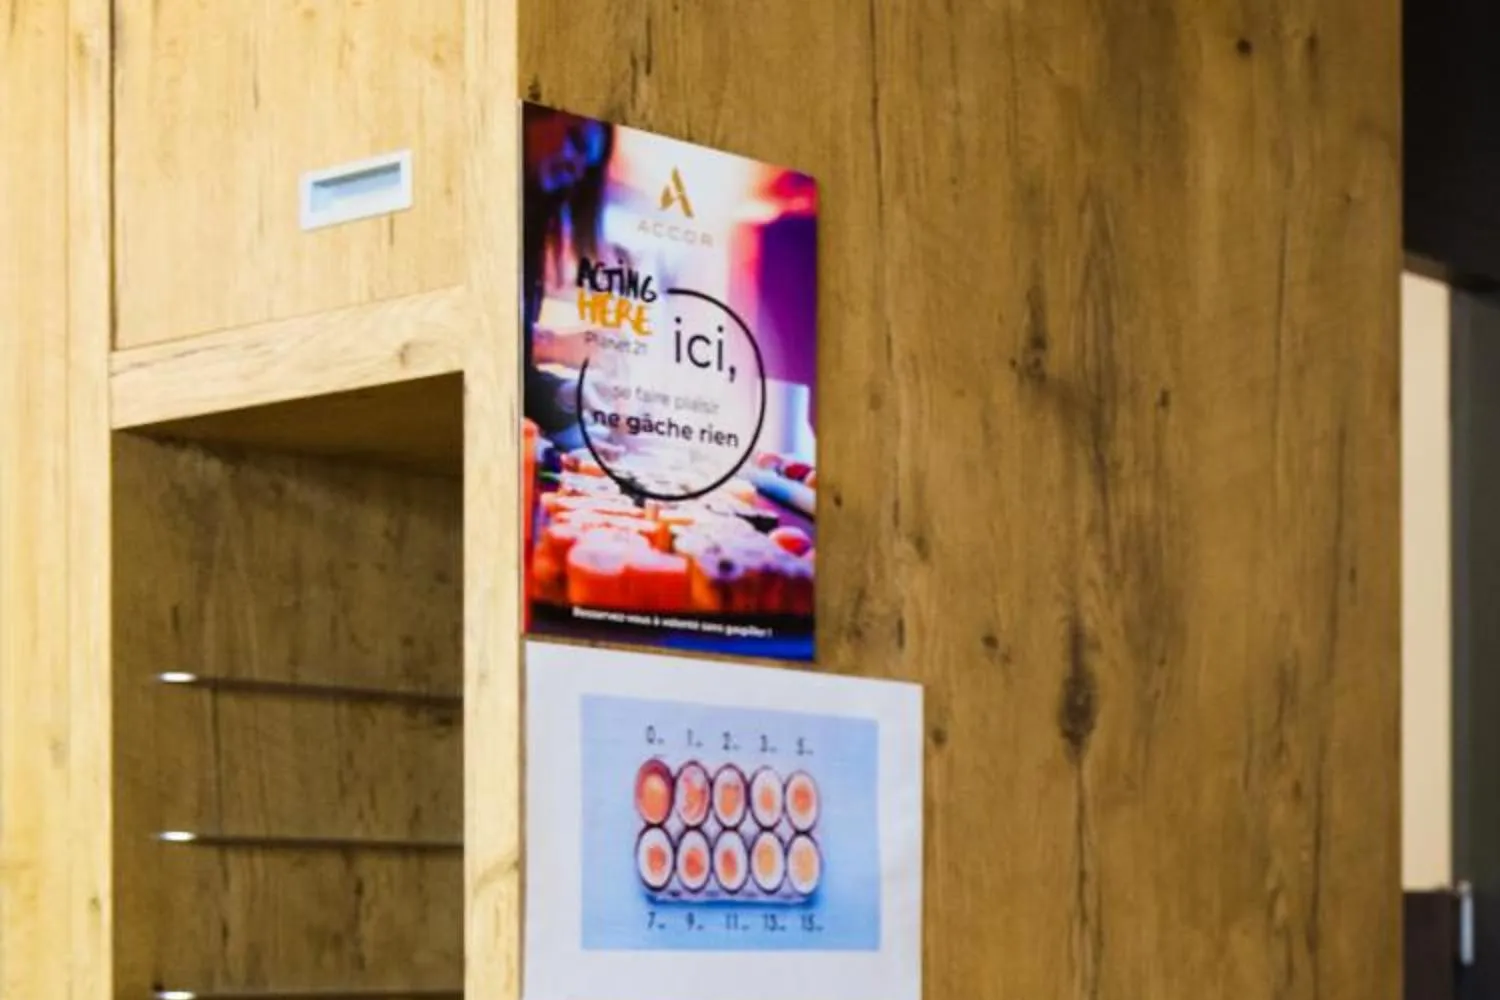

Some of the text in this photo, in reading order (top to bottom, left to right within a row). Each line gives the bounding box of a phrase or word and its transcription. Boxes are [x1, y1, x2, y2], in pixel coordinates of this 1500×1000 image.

[637, 219, 714, 248] ACCOR
[577, 288, 652, 336] HERE
[673, 316, 736, 383] ici,
[592, 409, 739, 449] ne gâche rien
